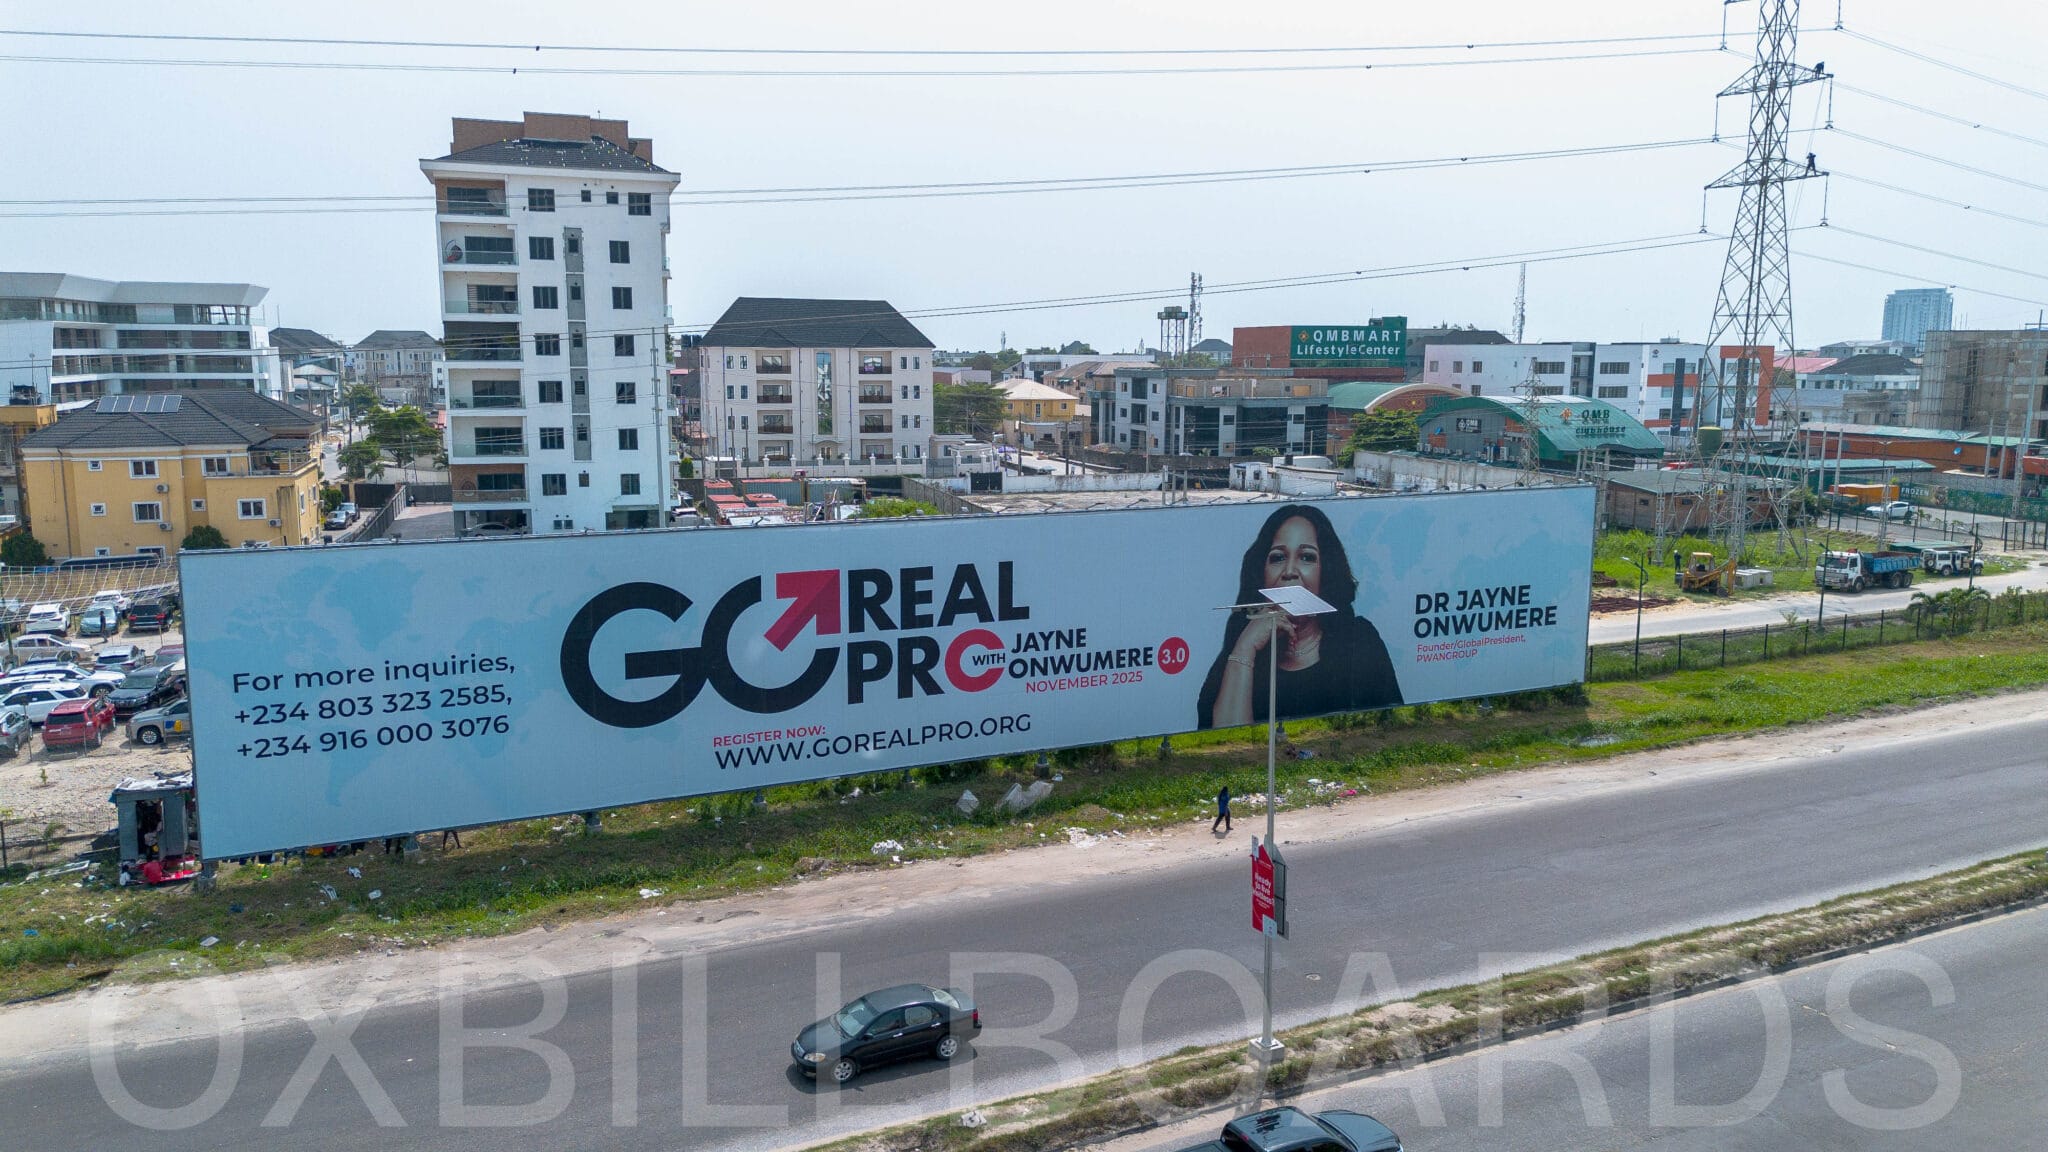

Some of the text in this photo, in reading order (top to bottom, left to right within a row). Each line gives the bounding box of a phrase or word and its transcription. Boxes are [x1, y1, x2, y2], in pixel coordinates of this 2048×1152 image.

[1313, 329, 1401, 343] QMBMART
[1582, 409, 1610, 420] QMB
[847, 560, 1030, 633] REAL
[1415, 584, 1531, 615] DR JAYNE
[1413, 605, 1558, 639] ONWUMERE
[559, 571, 841, 729] GO
[1011, 627, 1087, 654] JAYNE
[233, 653, 515, 693] For more inquiries,
[972, 652, 1006, 666] WITH
[1008, 646, 1185, 679] ONWUMERE 3.0
[1026, 671, 1143, 693] NOVEMBER 2025
[234, 684, 512, 725] +234 803 323 2585,
[237, 715, 510, 759] +234 916 000 3076
[713, 725, 826, 747] REGISTER NOW:
[715, 713, 1032, 769] WWW.GOREALPRO.ORG
